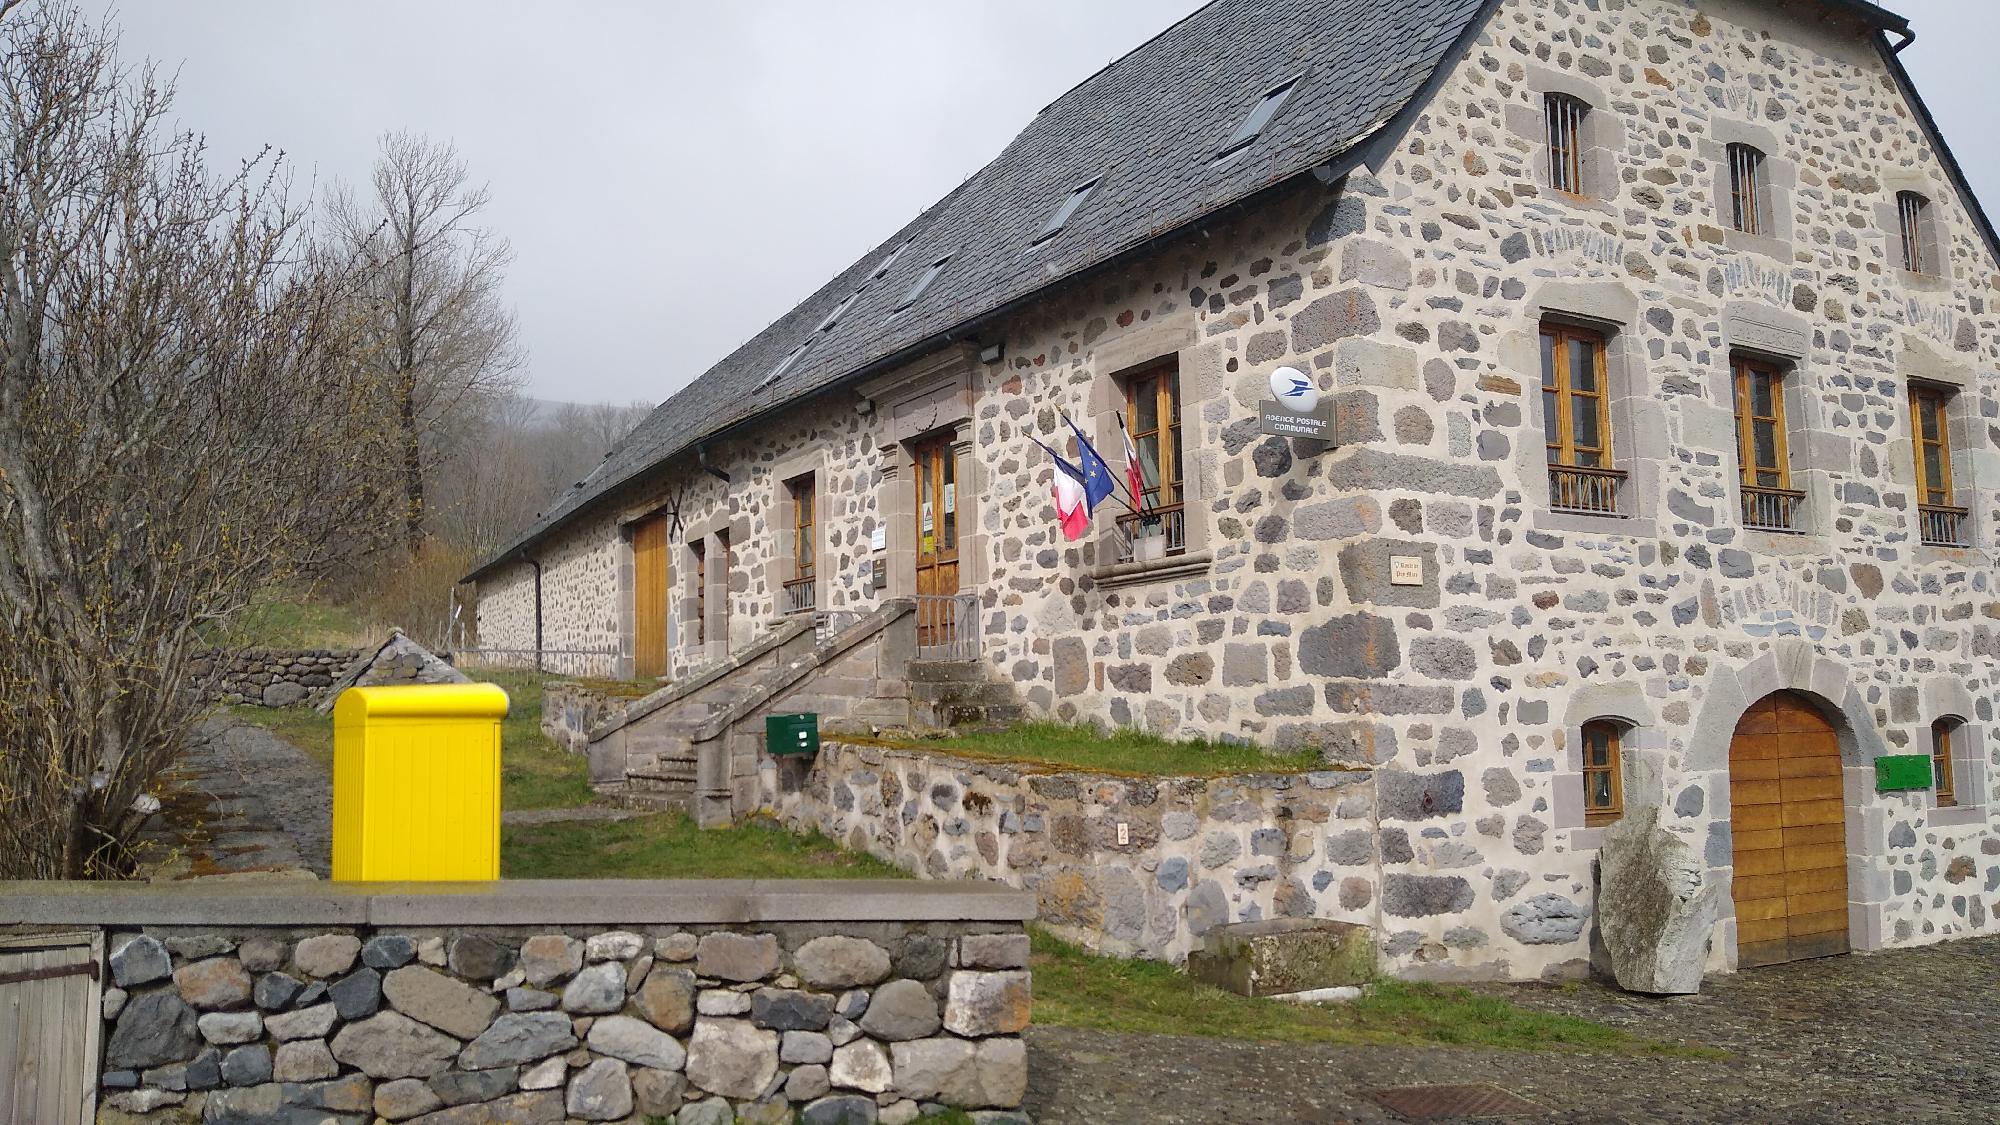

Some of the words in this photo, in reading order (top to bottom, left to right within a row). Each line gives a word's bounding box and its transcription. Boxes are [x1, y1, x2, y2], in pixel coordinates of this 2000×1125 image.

[1265, 414, 1294, 424] AGENCE
[1296, 417, 1327, 427] POSTALE
[1274, 423, 1318, 434] COMMUNALE
